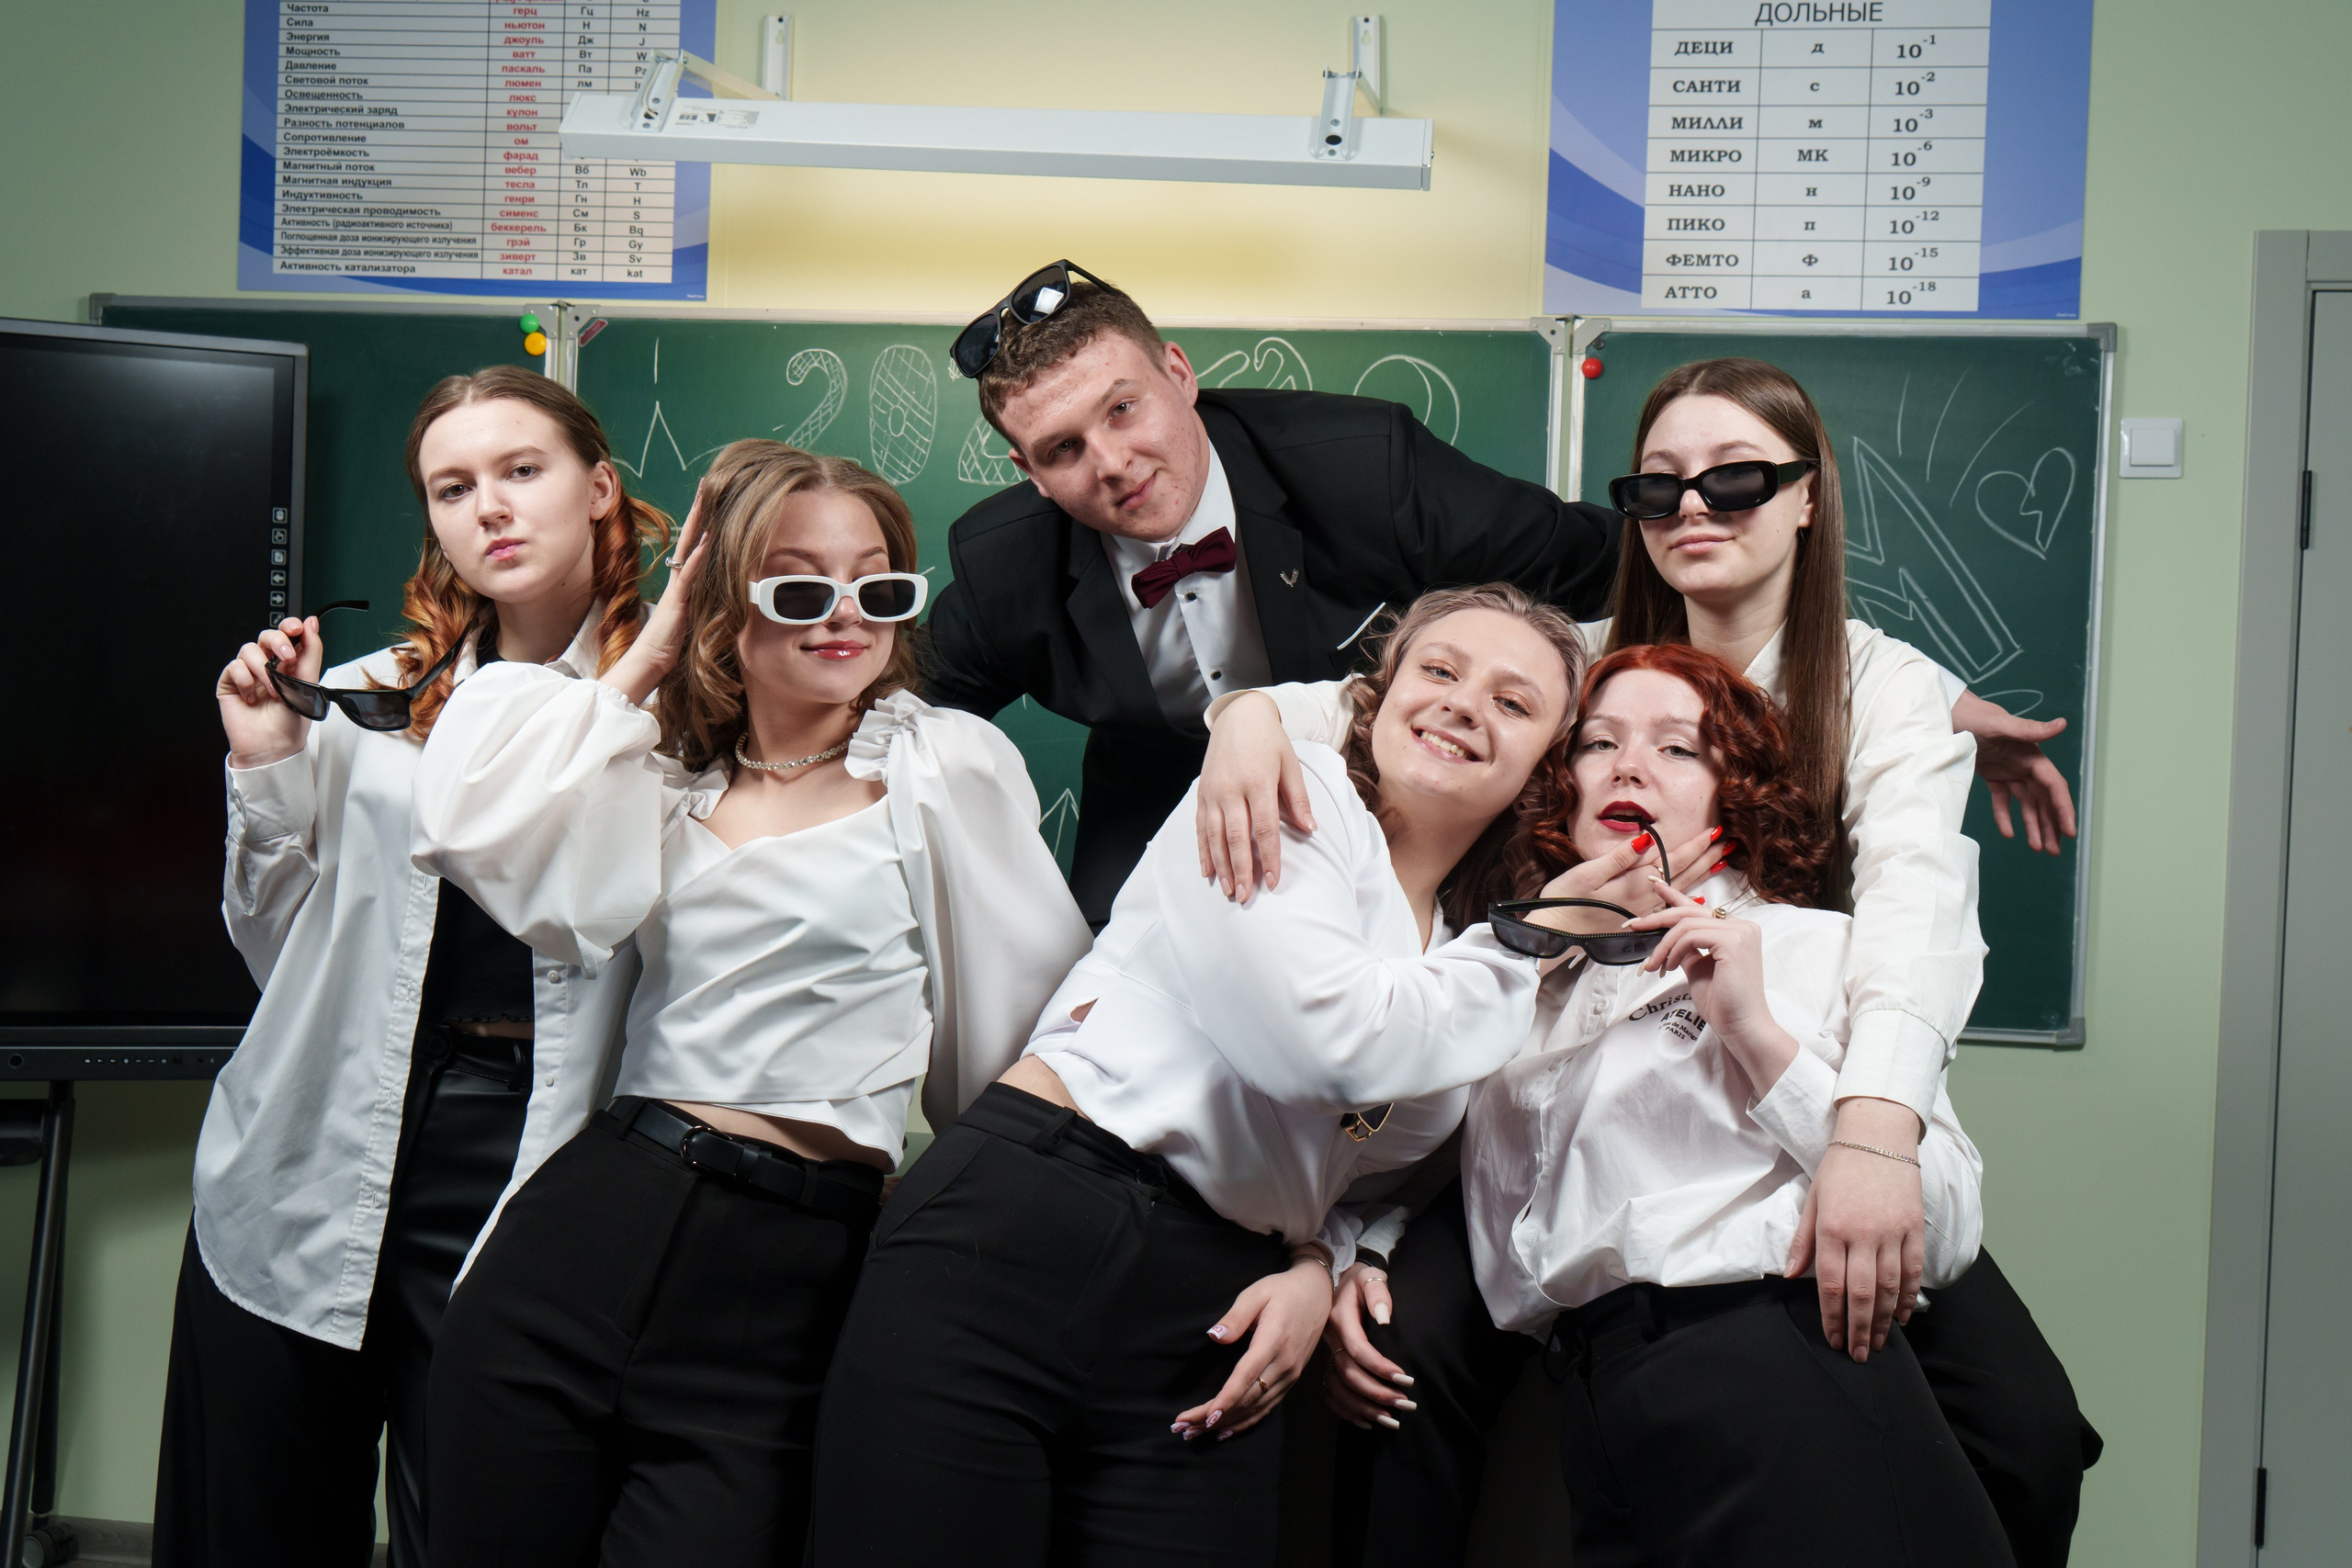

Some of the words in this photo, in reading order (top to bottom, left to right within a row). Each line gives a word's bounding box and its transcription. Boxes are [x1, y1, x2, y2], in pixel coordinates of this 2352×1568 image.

[287, 4, 329, 13] Частота
[512, 7, 537, 17] герц
[580, 6, 594, 17] Гц
[636, 8, 650, 17] Hz
[1755, 2, 1883, 26] ДОЛЬНЫЕ
[286, 17, 314, 27] Сила
[582, 21, 591, 30] Н
[639, 23, 647, 32] N
[286, 32, 330, 44] Энергия
[503, 36, 544, 46] джоуль
[577, 35, 594, 45] Дж
[639, 38, 645, 46] J
[286, 46, 341, 58] Мощность
[1674, 41, 1734, 56] ДЕЦИ
[1811, 43, 1825, 54] д
[579, 50, 593, 59] Вт
[636, 51, 647, 61] W
[285, 61, 337, 71] Давление
[501, 65, 546, 73] паскаль
[578, 64, 593, 74] Па
[285, 74, 336, 85] Световой
[339, 77, 369, 85] поток
[577, 80, 593, 88] лм
[1672, 80, 1741, 93] САНТИ
[1809, 82, 1820, 91] с
[284, 89, 363, 100] Освещенность
[509, 94, 537, 102] люкс
[284, 103, 364, 115] Электрический
[367, 106, 398, 116] заряд
[507, 109, 538, 118] кулон
[284, 118, 333, 128] Разность
[335, 121, 405, 130] потенциалов
[506, 123, 537, 131] вольт
[1670, 116, 1743, 130] МИЛЛИ
[1808, 118, 1823, 129] м
[283, 132, 367, 144] Сопротивление
[283, 146, 370, 158] Электроёмкость
[503, 151, 539, 162] фарад
[1669, 149, 1742, 163] МИКРО
[1797, 148, 1829, 162] МК
[283, 160, 343, 171] Магнитный
[345, 164, 375, 172] поток
[504, 165, 537, 175] вебер
[575, 165, 590, 175] Вб
[629, 167, 647, 177] Wb
[282, 175, 339, 185] Магнитная
[341, 178, 392, 188] индукция
[505, 181, 536, 189] тесла
[575, 180, 588, 189] Тл
[634, 182, 642, 191] T
[282, 189, 363, 202] Индуктивность
[1668, 184, 1725, 197] НАНО
[1805, 186, 1818, 197] н
[504, 195, 535, 205] генри
[575, 194, 588, 204] Гн
[633, 197, 642, 206] H
[282, 203, 361, 216] Электрическая
[363, 206, 441, 217] проводимость
[499, 209, 539, 218] сименс
[572, 209, 589, 218] См
[633, 211, 640, 220] S
[281, 218, 331, 228] Активность
[333, 219, 404, 230] (радиоактивного
[406, 220, 453, 231] источника)
[490, 222, 547, 234] беккерель
[573, 223, 588, 232] Бк
[1667, 218, 1726, 231] ПИКО
[1804, 220, 1816, 231] п
[629, 225, 644, 237] Bq
[280, 231, 338, 242] Поглощенная
[339, 233, 360, 243] доза
[361, 234, 430, 245] ионизирующего
[431, 236, 477, 246] излучения
[506, 237, 531, 247] грэй
[573, 237, 587, 248] Гр
[628, 240, 643, 251] Gy
[280, 245, 339, 256] Эффективная
[341, 248, 362, 257] доза
[363, 249, 432, 259] ионизирующего
[433, 250, 479, 260] излучения
[572, 252, 587, 262] Зв
[499, 253, 537, 263] зиверт
[628, 254, 642, 264] Sv
[1665, 254, 1739, 267] ФЕМТО
[280, 261, 342, 271] Активность
[345, 264, 416, 274] катализатора
[503, 267, 533, 276] катал
[627, 269, 644, 278] kat
[1664, 287, 1718, 299] АТТО
[1801, 289, 1812, 299] а
[1629, 993, 1692, 1021] Christ
[1660, 1008, 1707, 1032] ATELIE
[1665, 1027, 1685, 1039] PARIS
